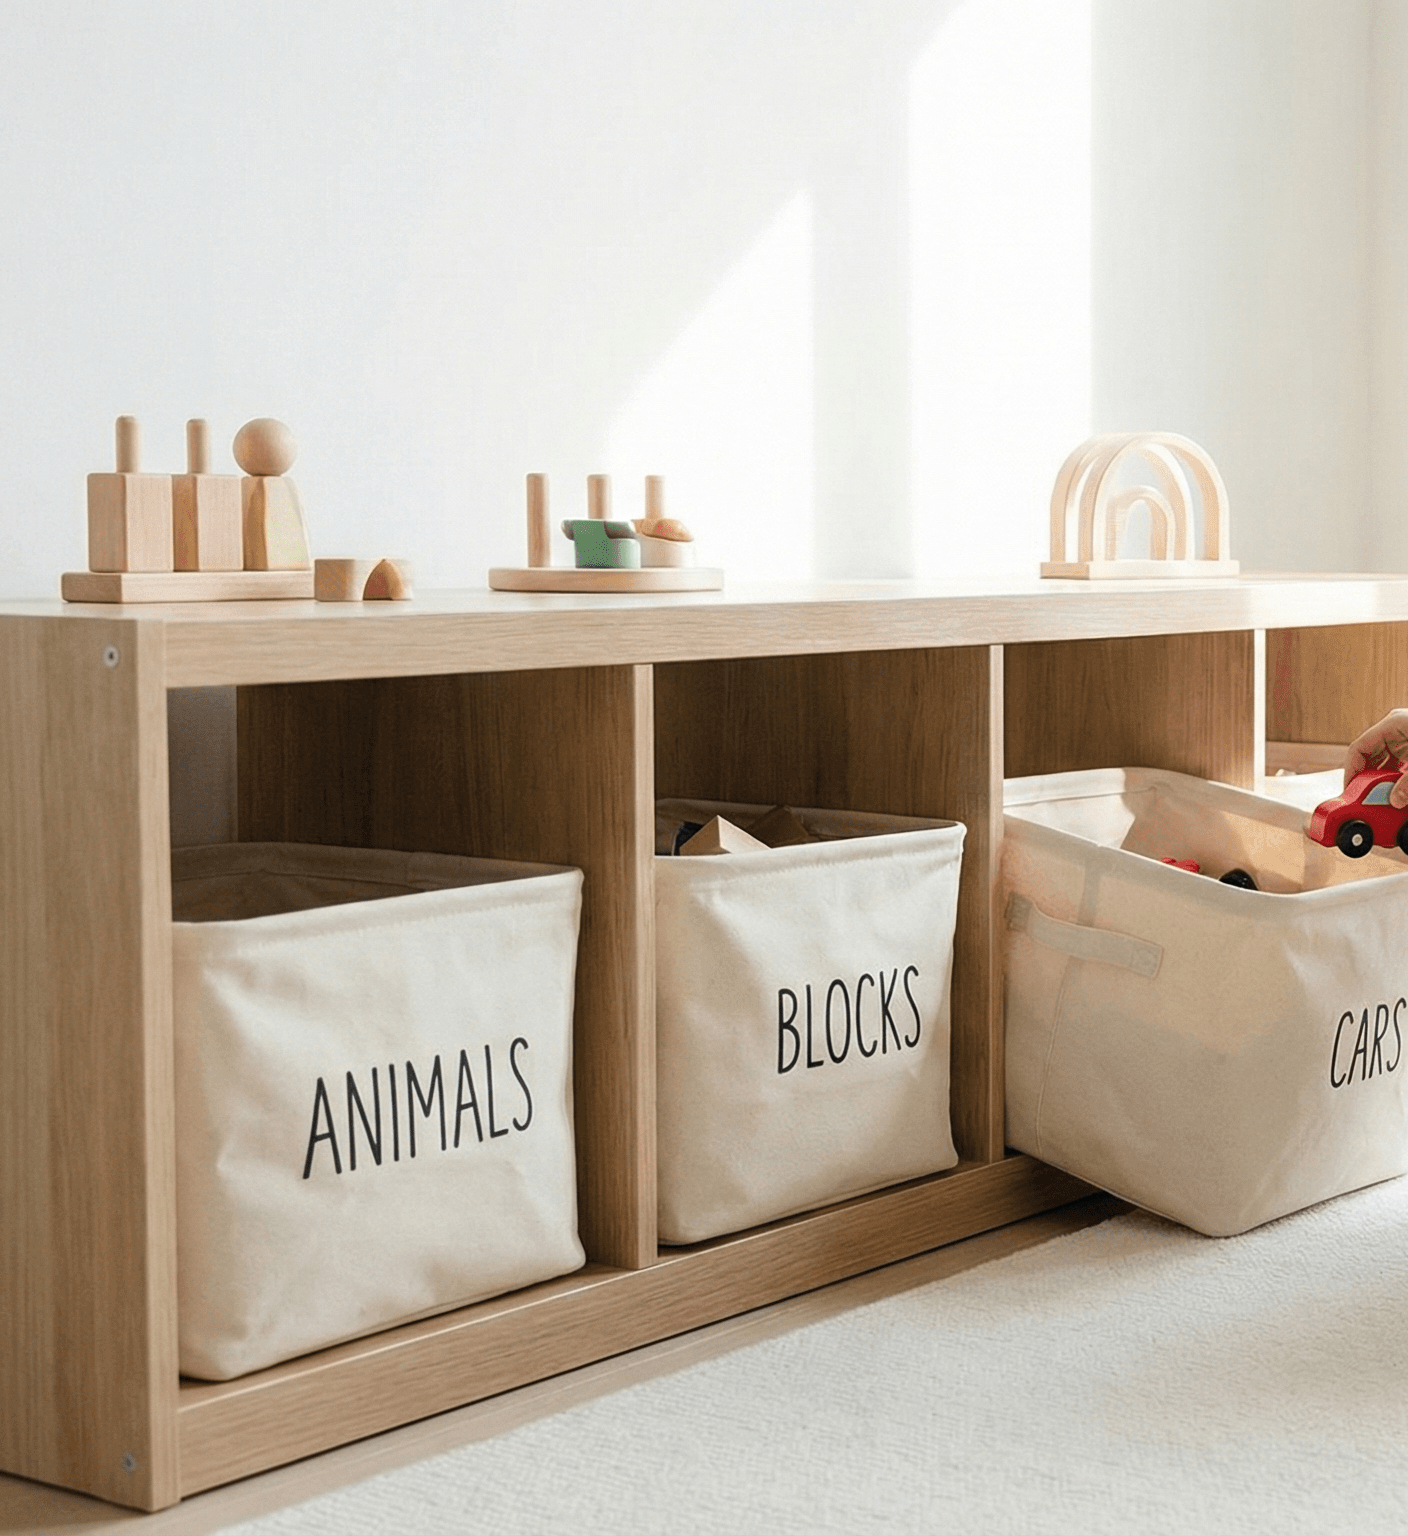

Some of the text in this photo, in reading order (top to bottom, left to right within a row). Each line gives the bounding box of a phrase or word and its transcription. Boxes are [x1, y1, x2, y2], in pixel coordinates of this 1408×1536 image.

[777, 965, 921, 1074] BLOCKS
[1330, 997, 1407, 1089] CARS
[302, 1037, 533, 1180] ANIMALS
